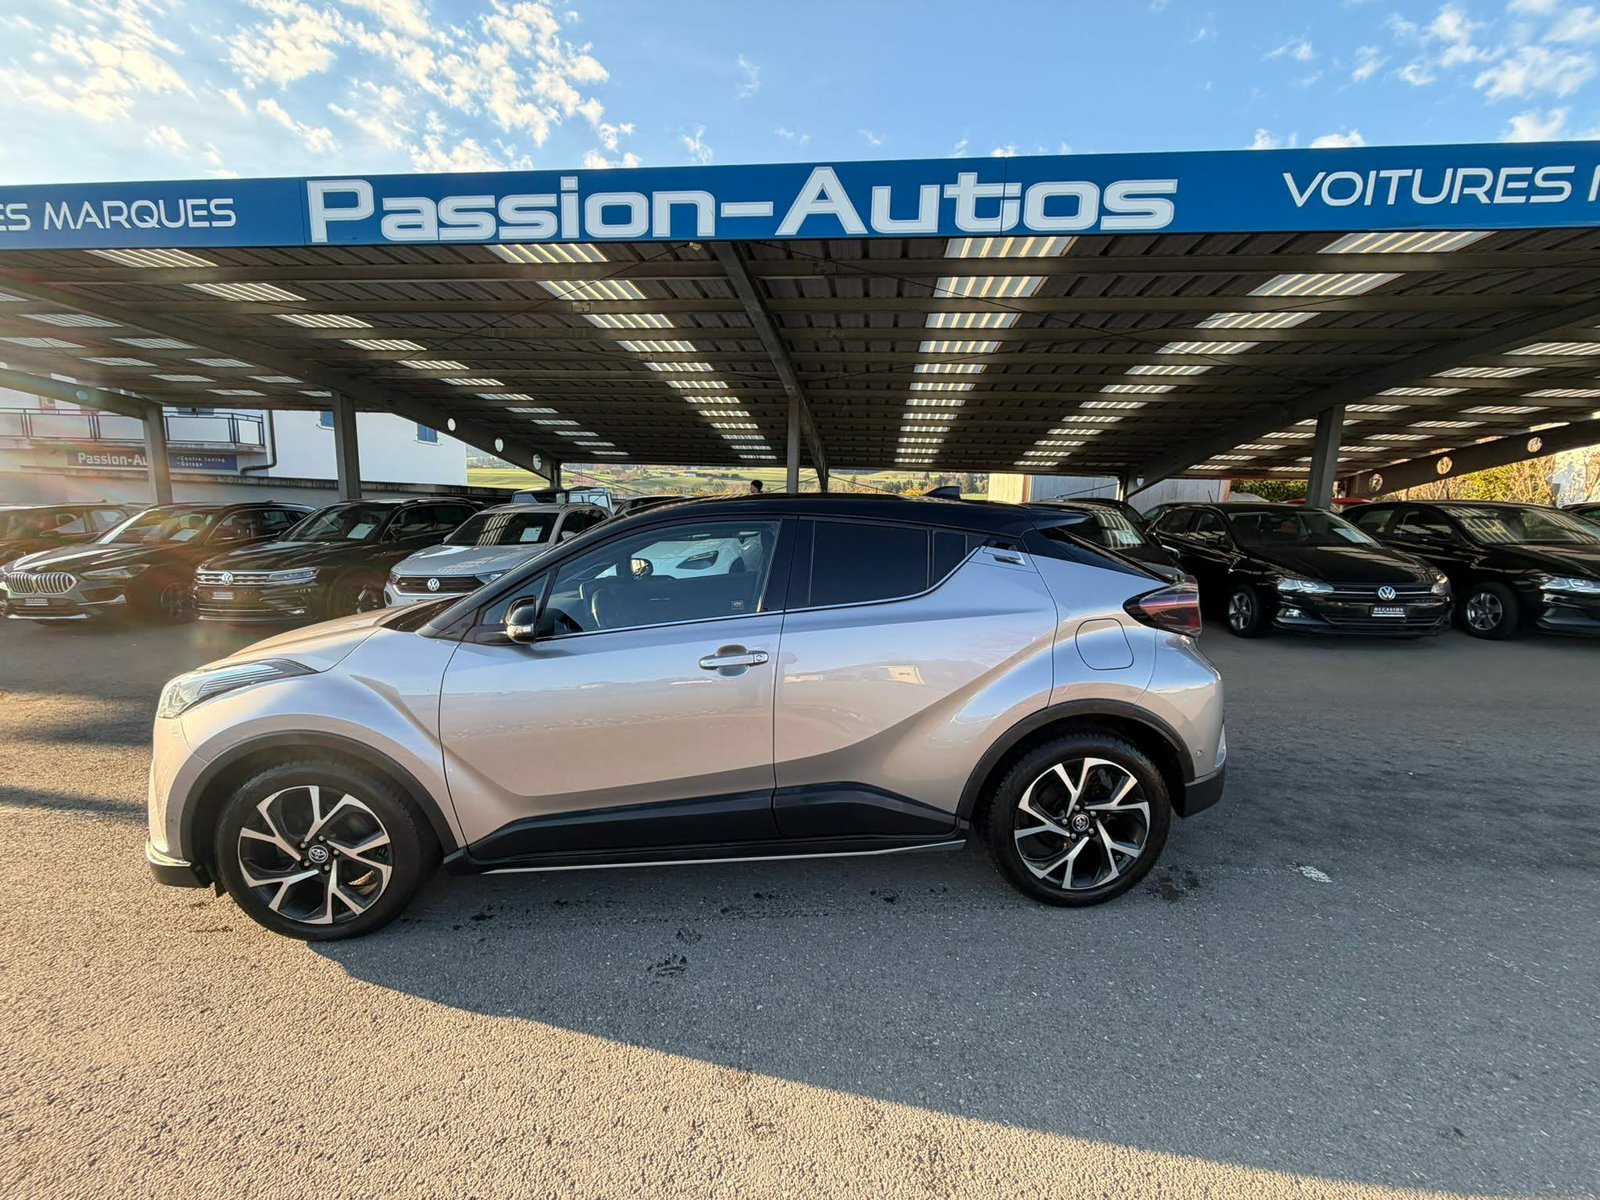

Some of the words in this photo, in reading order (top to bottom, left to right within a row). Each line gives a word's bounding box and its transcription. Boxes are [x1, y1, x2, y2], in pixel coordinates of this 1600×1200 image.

[306, 166, 1178, 243] Passion-Autos
[1283, 165, 1576, 207] VOITURES
[0, 203, 31, 231] S
[44, 198, 237, 230] MARQUES
